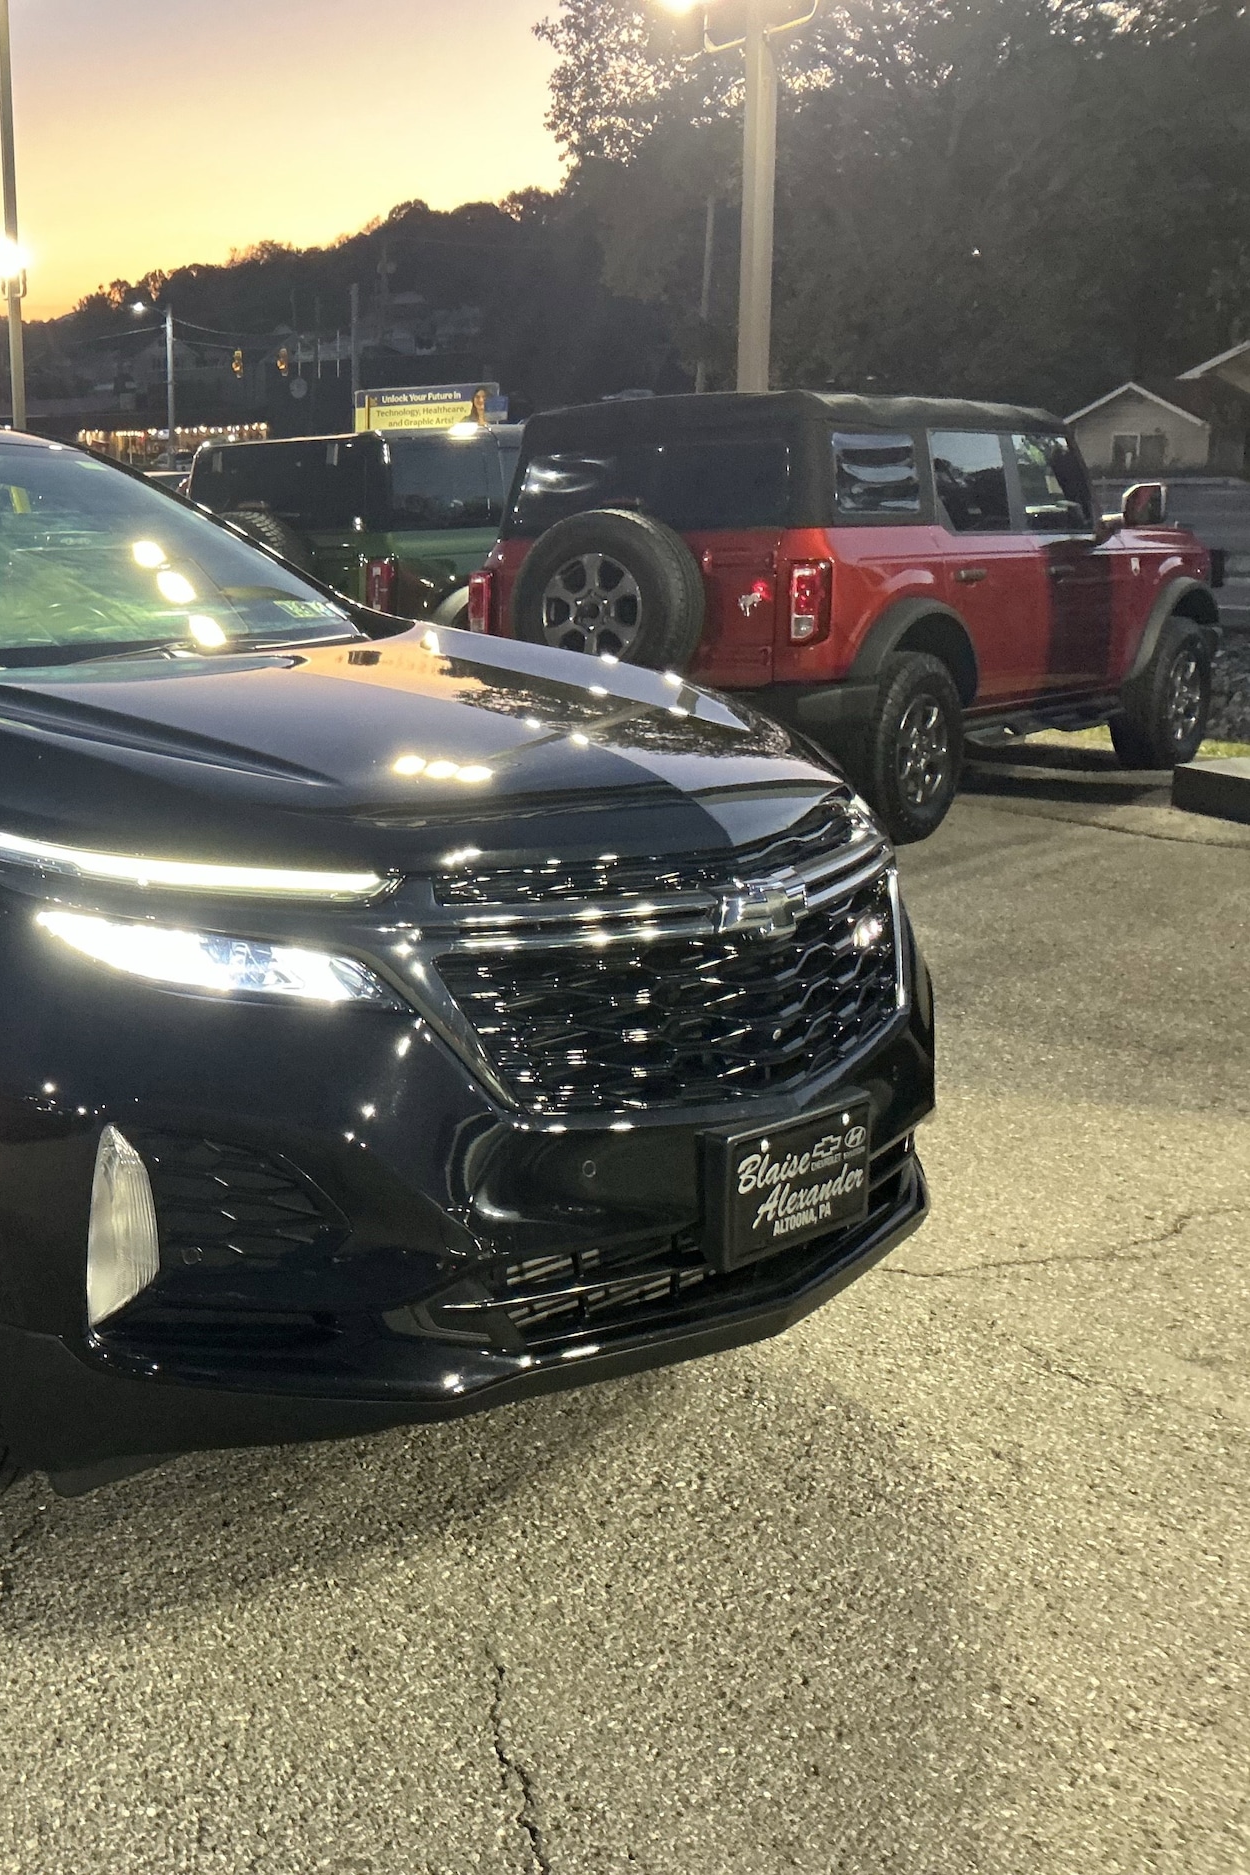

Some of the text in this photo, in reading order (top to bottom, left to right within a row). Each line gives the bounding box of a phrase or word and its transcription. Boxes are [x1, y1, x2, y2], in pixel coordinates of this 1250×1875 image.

[382, 394, 408, 404] Unlock
[409, 394, 427, 402] Your
[428, 392, 453, 401] Future
[376, 405, 466, 417] Technology, Healthcare,
[388, 416, 454, 428] and Graphic Arts!
[737, 1152, 810, 1194] Blaise
[752, 1163, 864, 1229] Alexander
[773, 1202, 832, 1236] ALTOONA, PA
